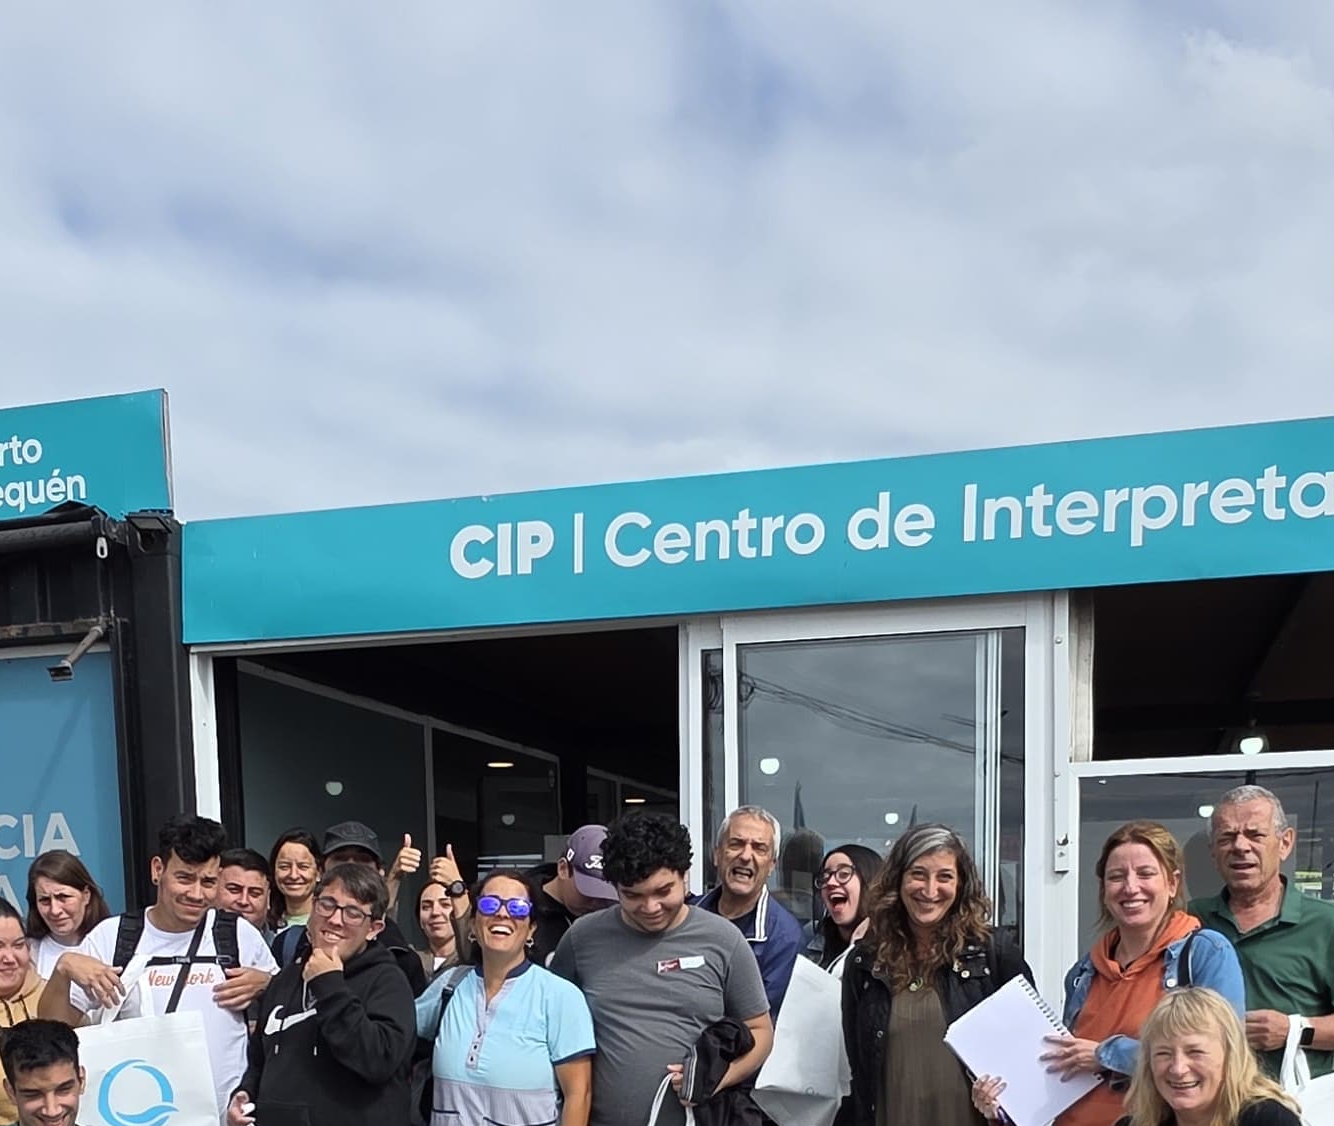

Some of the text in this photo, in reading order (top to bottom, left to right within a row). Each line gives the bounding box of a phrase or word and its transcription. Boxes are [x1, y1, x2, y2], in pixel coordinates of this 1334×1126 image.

[450, 519, 555, 579] CIP
[604, 508, 826, 568] Centro
[847, 491, 935, 550] de
[148, 967, 215, 986] New ork
